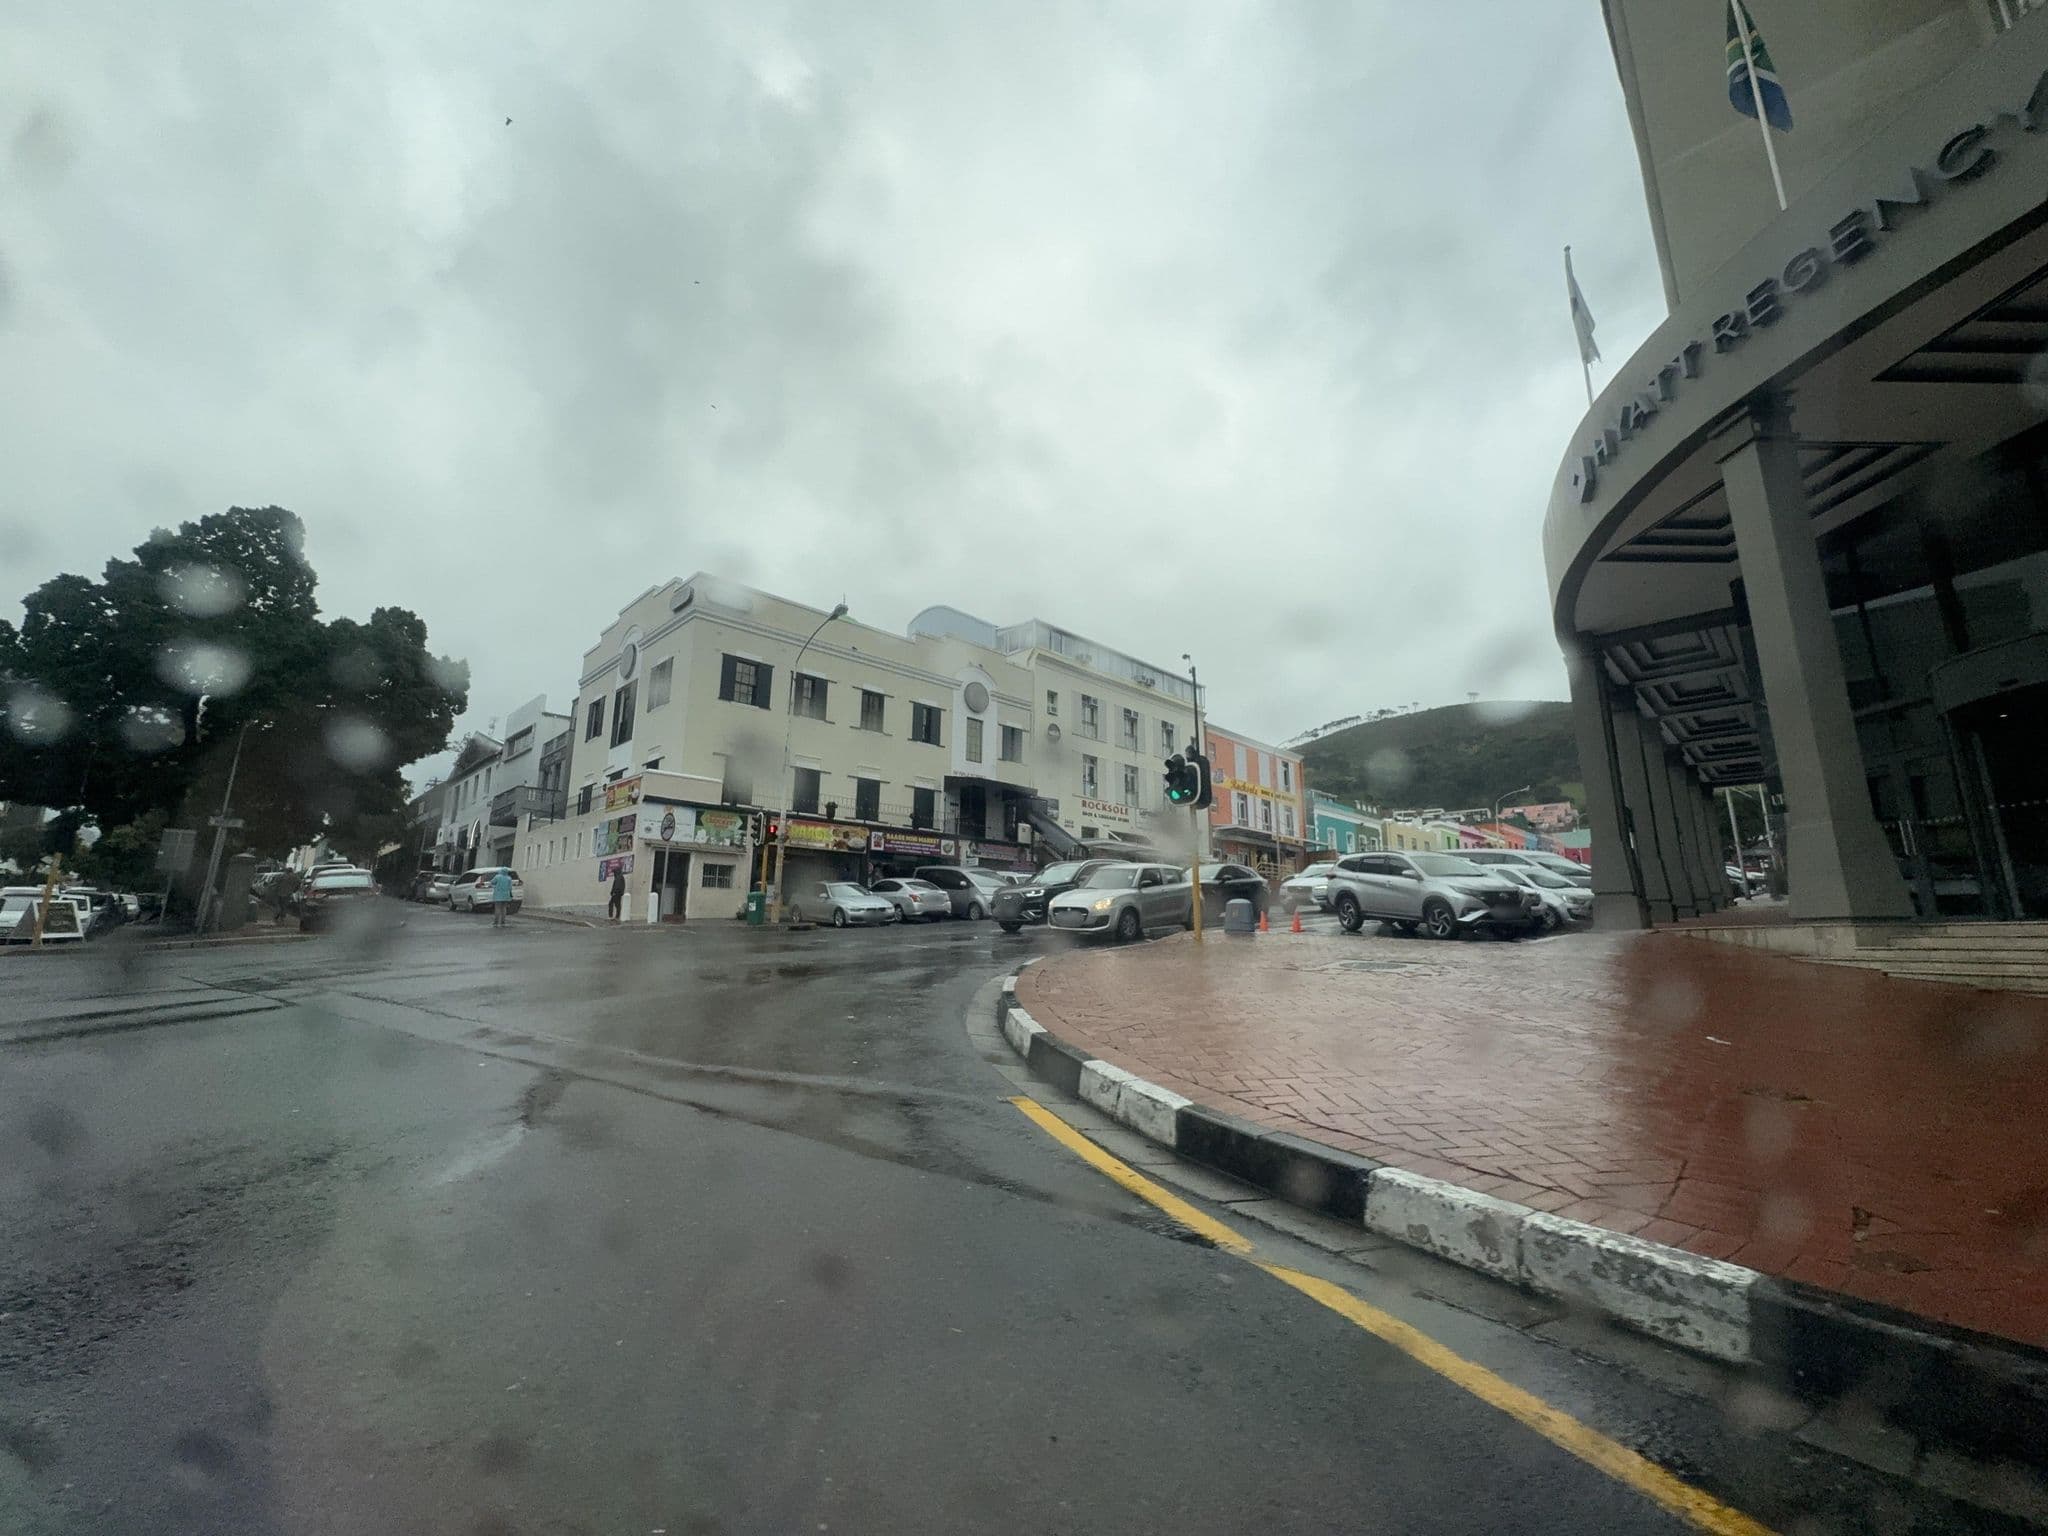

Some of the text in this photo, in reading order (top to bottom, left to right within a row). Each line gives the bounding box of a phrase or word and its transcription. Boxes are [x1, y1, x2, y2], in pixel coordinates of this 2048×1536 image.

[1590, 67, 2048, 468] HYATT REGENCY
[1081, 799, 1129, 816] ROCKSOLE
